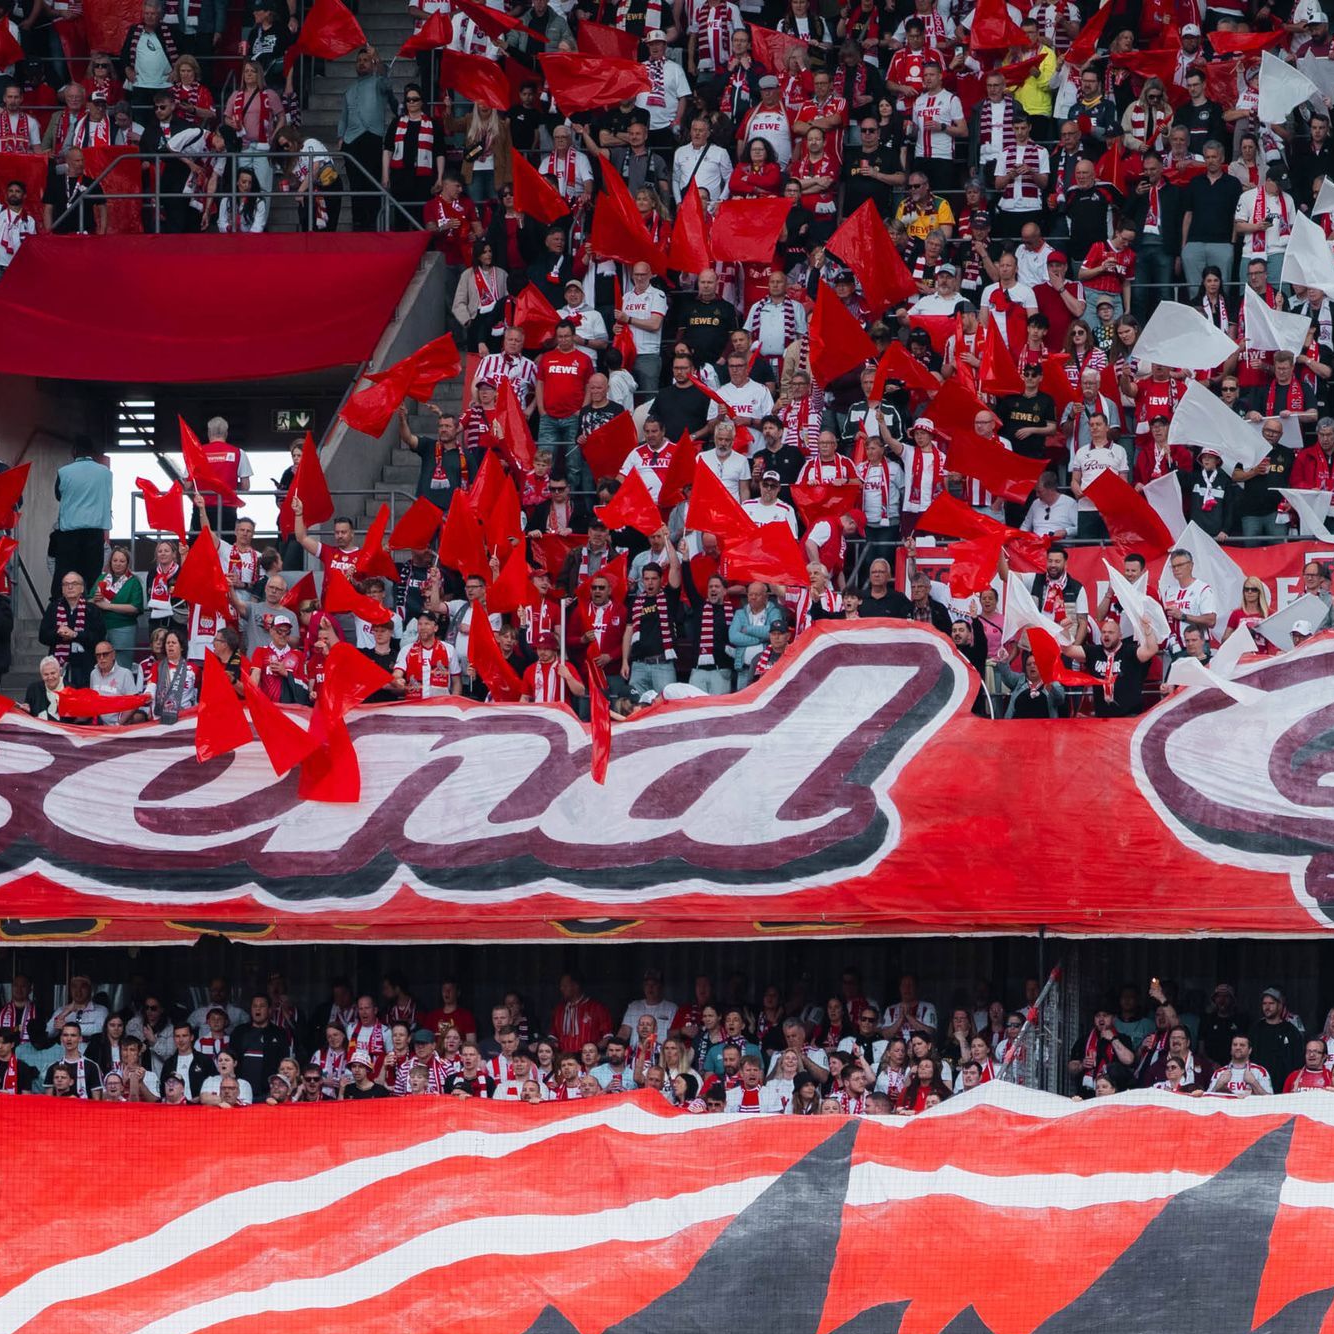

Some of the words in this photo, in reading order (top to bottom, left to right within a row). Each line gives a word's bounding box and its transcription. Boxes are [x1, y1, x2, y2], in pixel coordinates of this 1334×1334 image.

[917, 106, 940, 117] REWE
[752, 121, 780, 132] REWE
[549, 364, 579, 375] REWE
[1010, 411, 1035, 423] REWE
